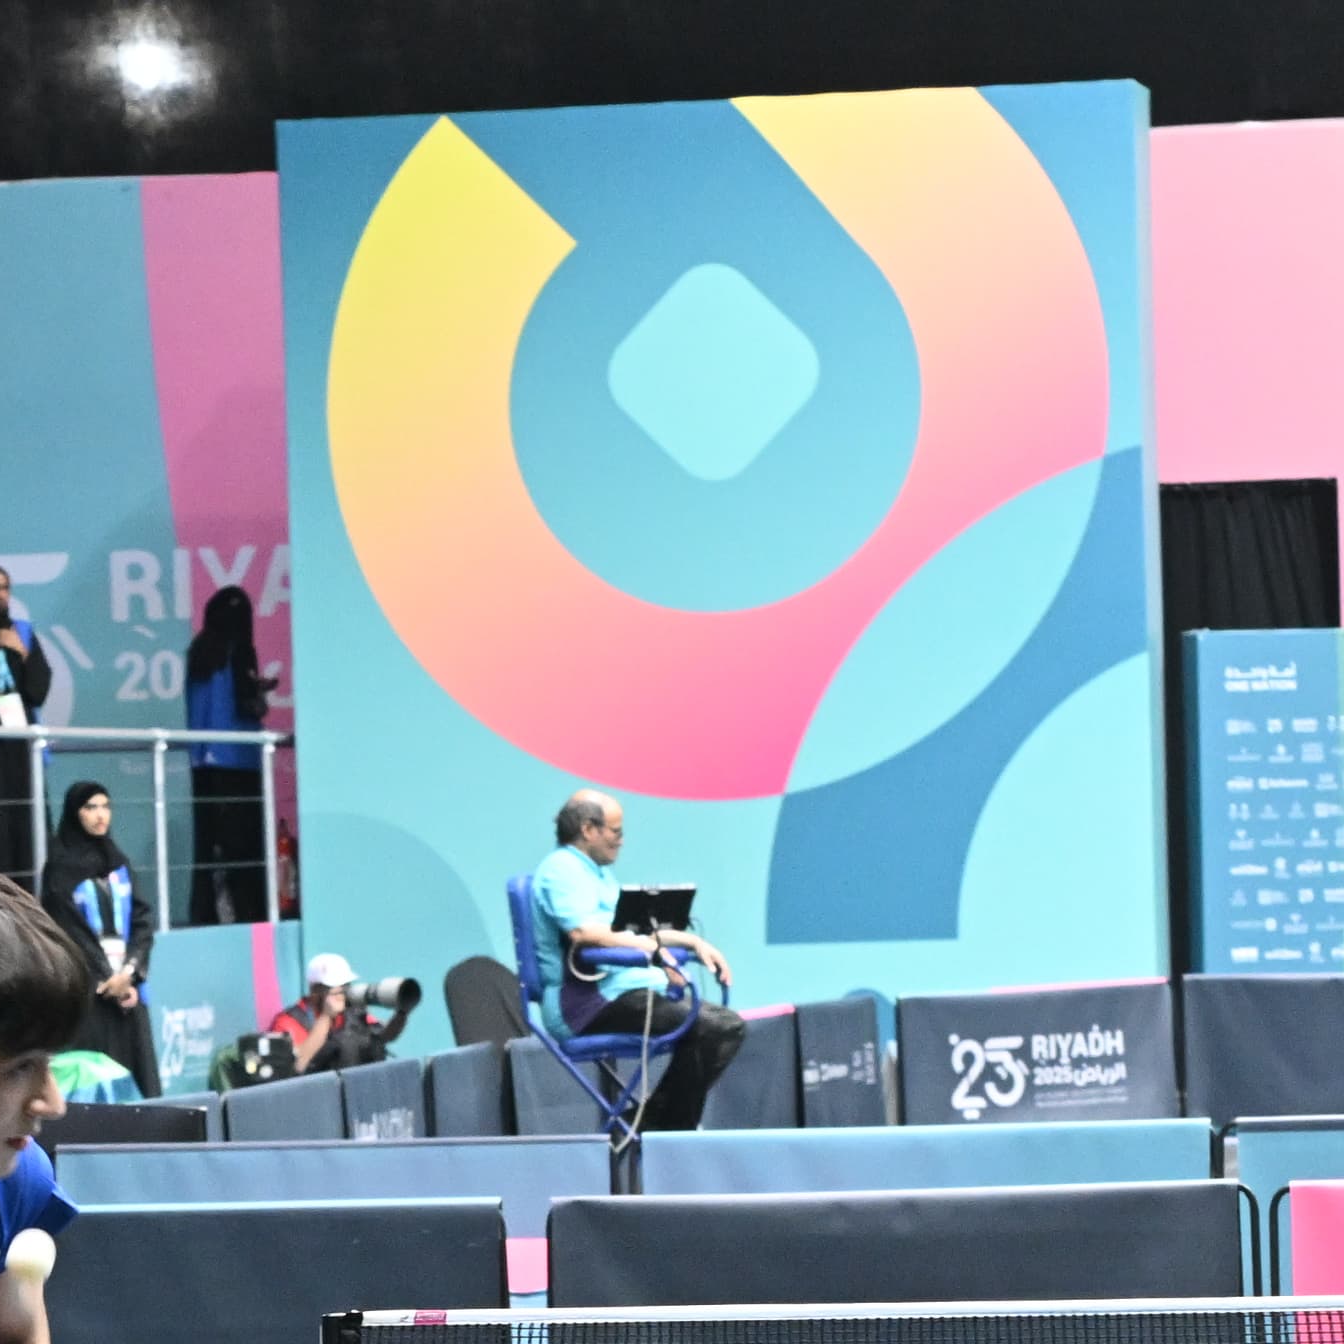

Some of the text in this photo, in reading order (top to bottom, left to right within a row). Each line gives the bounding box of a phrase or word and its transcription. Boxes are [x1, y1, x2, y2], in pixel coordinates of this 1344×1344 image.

[1031, 1025, 1125, 1063] RIYADH
[949, 1034, 1029, 1119] 25
[1033, 1065, 1073, 1086] 2025
